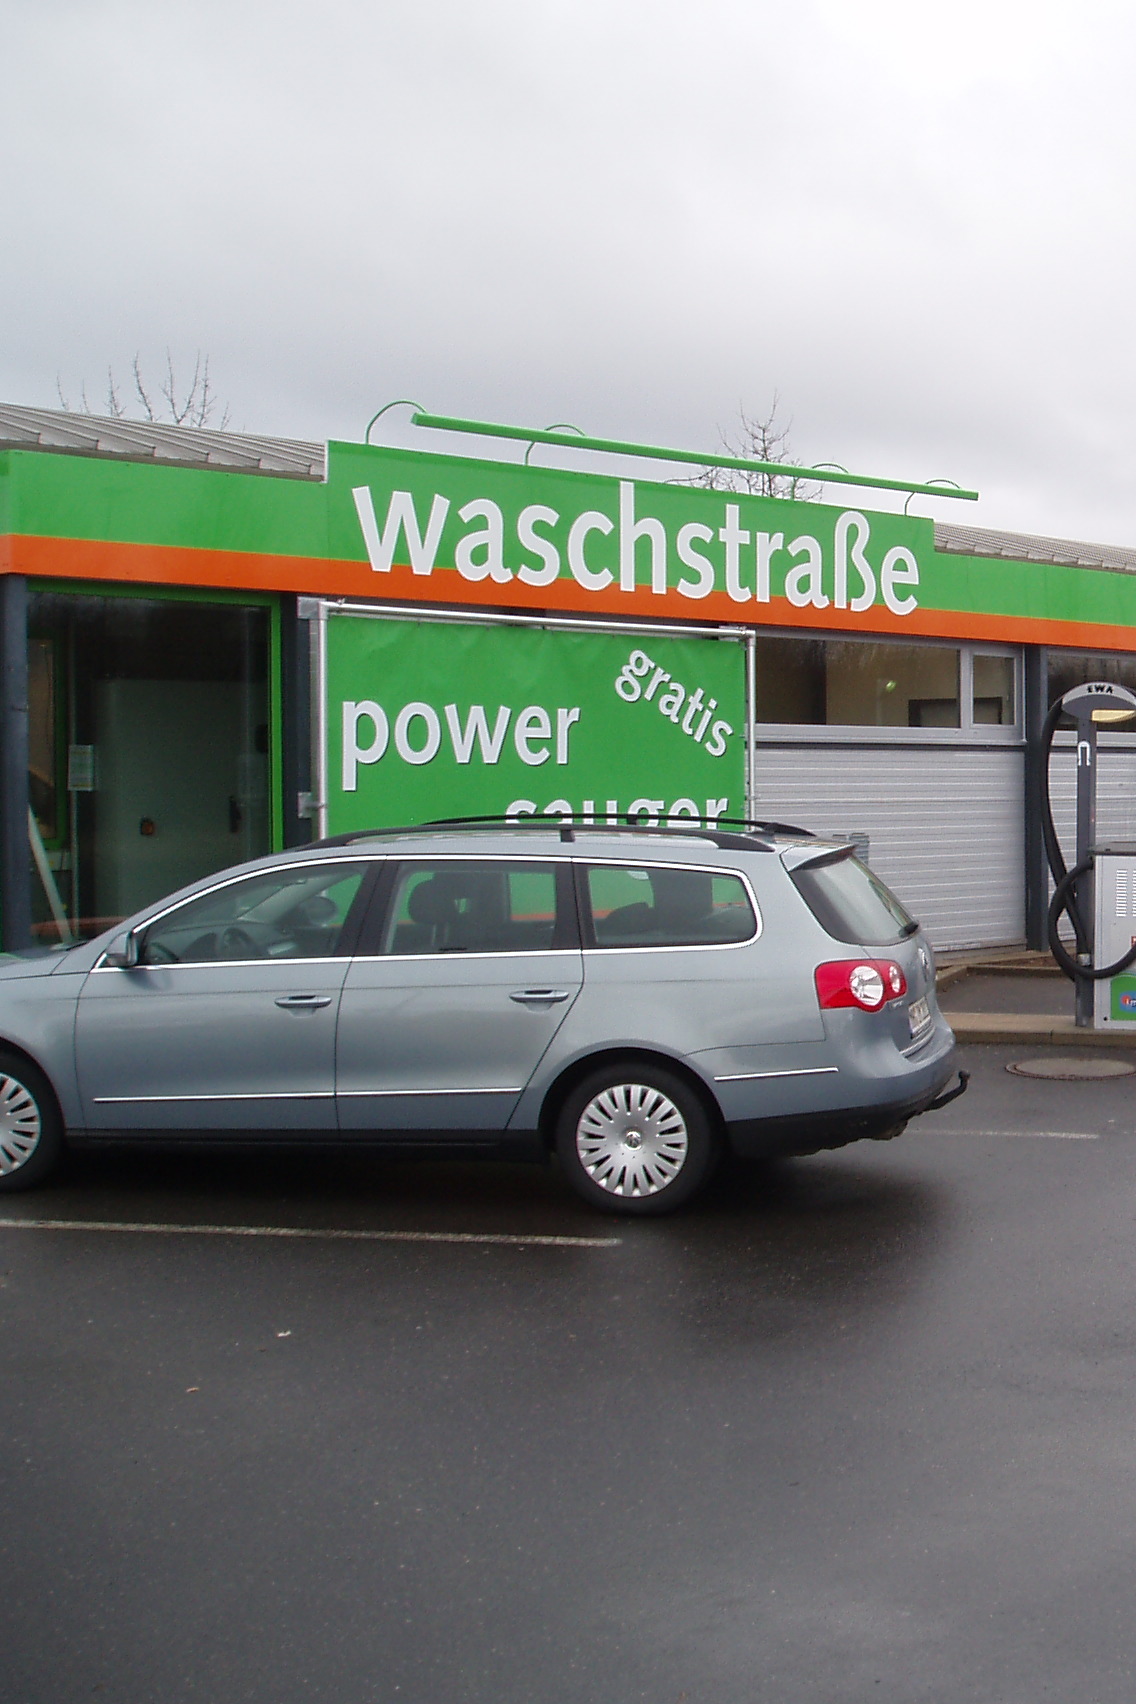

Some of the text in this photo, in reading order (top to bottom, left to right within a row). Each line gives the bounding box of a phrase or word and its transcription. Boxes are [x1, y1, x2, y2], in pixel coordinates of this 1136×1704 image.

[352, 480, 920, 616] waschstraße
[342, 699, 581, 792] power
[614, 649, 735, 757] gratis
